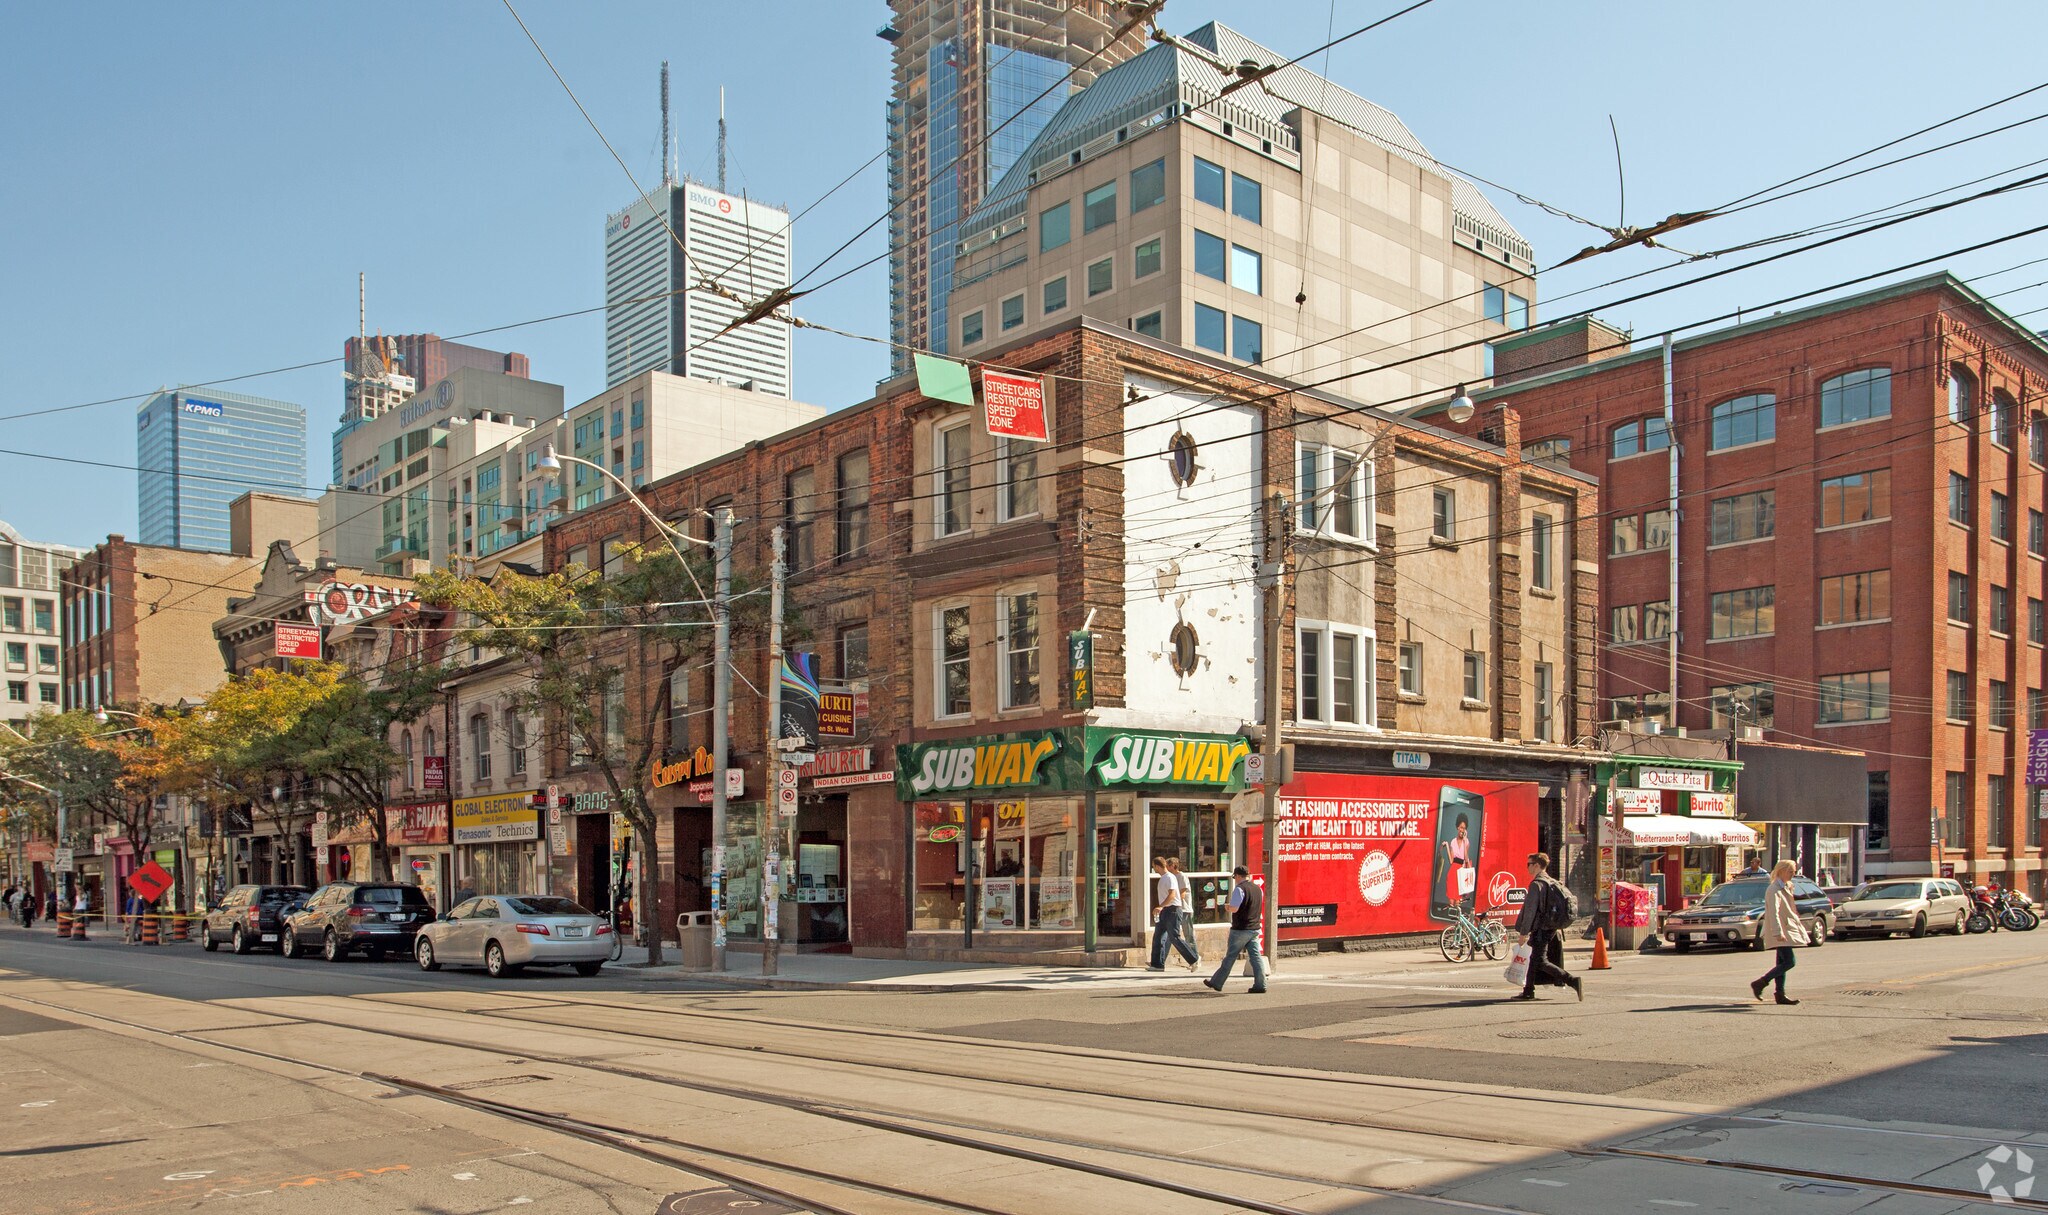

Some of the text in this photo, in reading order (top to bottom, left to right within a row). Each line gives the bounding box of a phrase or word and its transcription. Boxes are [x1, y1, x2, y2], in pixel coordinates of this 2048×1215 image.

[689, 192, 717, 208] BMO
[607, 222, 621, 237] BMO
[986, 380, 1041, 398] STREETCARS
[987, 393, 1040, 410] RESTRICTED
[185, 403, 221, 417] KPMG
[400, 399, 433, 427] Hilton
[988, 404, 1017, 418] SPEED
[989, 416, 1014, 429] ZONE
[278, 627, 319, 637] STREETCARS
[278, 634, 317, 643] RESTRICTED
[1074, 640, 1088, 700] SUBWAY
[822, 713, 853, 723] CUISINE
[827, 725, 835, 733] St.
[836, 726, 850, 734] West
[911, 735, 1056, 796] SUBWAY
[1098, 735, 1252, 786] SUBWAY
[1396, 752, 1421, 764] TITAN
[815, 777, 840, 787] INDIAN
[840, 775, 869, 784] CUISINE
[1648, 770, 1701, 785] Quick Pita
[455, 797, 529, 817] GLOBAL ELECTRONI
[1295, 802, 1338, 817] FASHION
[1340, 804, 1405, 819] ACCESSORIES
[1407, 804, 1429, 819] JUST
[1691, 797, 1724, 812] Burrito
[416, 804, 446, 828] PALACE
[457, 824, 534, 840] Panasonic Technics
[932, 828, 956, 839] OPEN
[1312, 821, 1347, 836] MEANT
[1350, 821, 1362, 836] TO
[1365, 822, 1377, 836] BE
[1380, 821, 1421, 837] VINTAGE.
[1635, 833, 1689, 843] Mediterranean Food
[1722, 833, 1750, 842] Burritos
[1286, 843, 1295, 851] get
[1305, 842, 1313, 850] off
[1361, 871, 1392, 890] SUPERTAB
[1491, 873, 1526, 903] Virgin mobile
